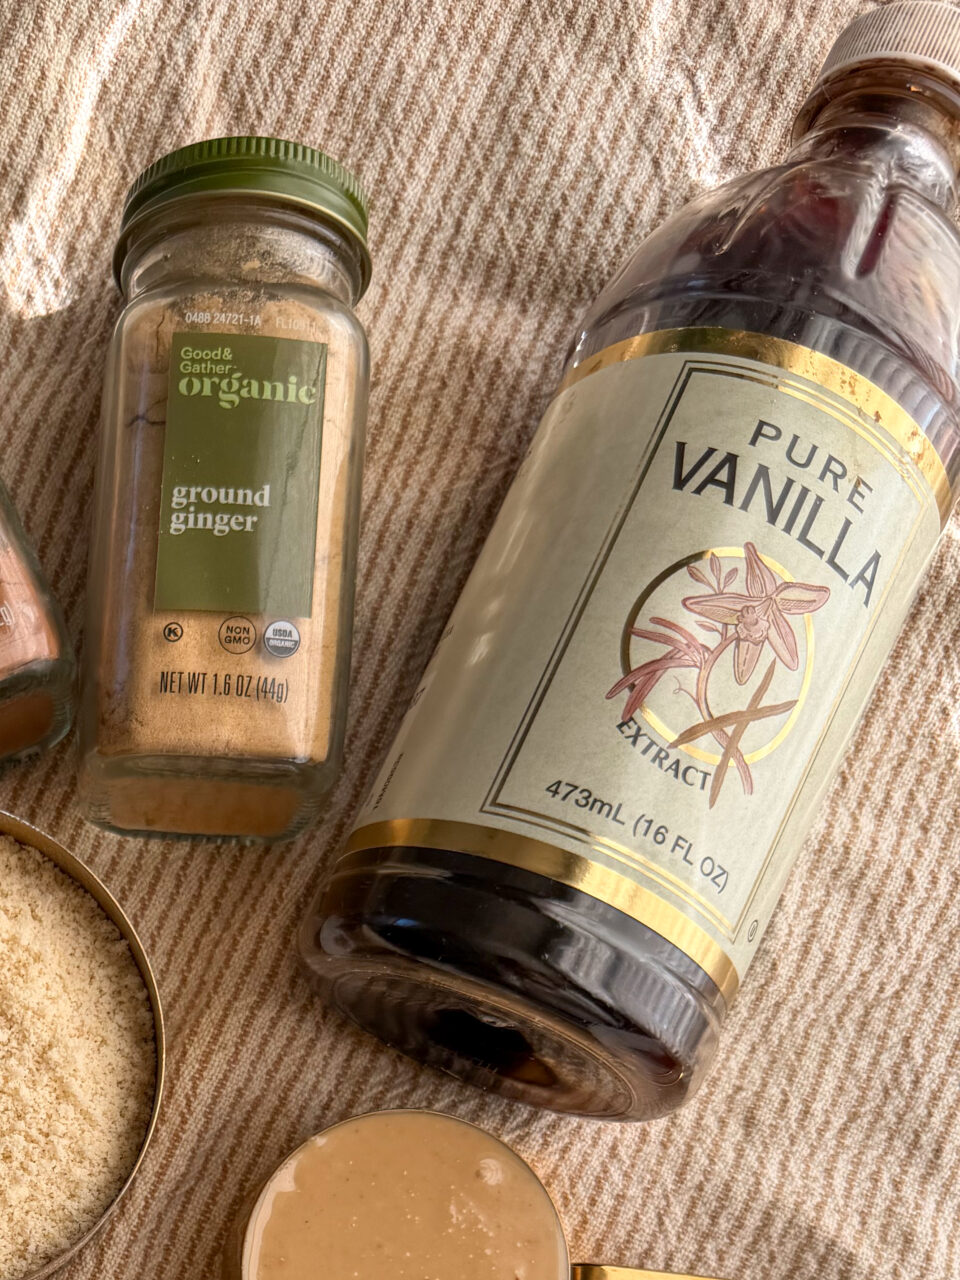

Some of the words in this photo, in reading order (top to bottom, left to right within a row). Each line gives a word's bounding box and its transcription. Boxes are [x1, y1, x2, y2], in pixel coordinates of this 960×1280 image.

[179, 360, 232, 374] Gather
[178, 372, 317, 410] organic
[748, 419, 874, 515] PURE
[171, 484, 272, 510] ground
[169, 506, 258, 536] ginger
[672, 441, 882, 608] VANILLA
[224, 635, 251, 646] GMO
[225, 625, 250, 637] NON
[272, 627, 293, 638] USDA
[159, 671, 184, 694] NET
[188, 672, 208, 695] WT
[213, 673, 231, 696] 1.6
[236, 674, 252, 698] OZ
[256, 675, 289, 704] (44g)
[616, 716, 712, 791] EXTRACT
[545, 779, 626, 826] 473mL
[632, 813, 669, 846] (16
[670, 834, 694, 866] FL
[699, 856, 729, 895] OZ)
